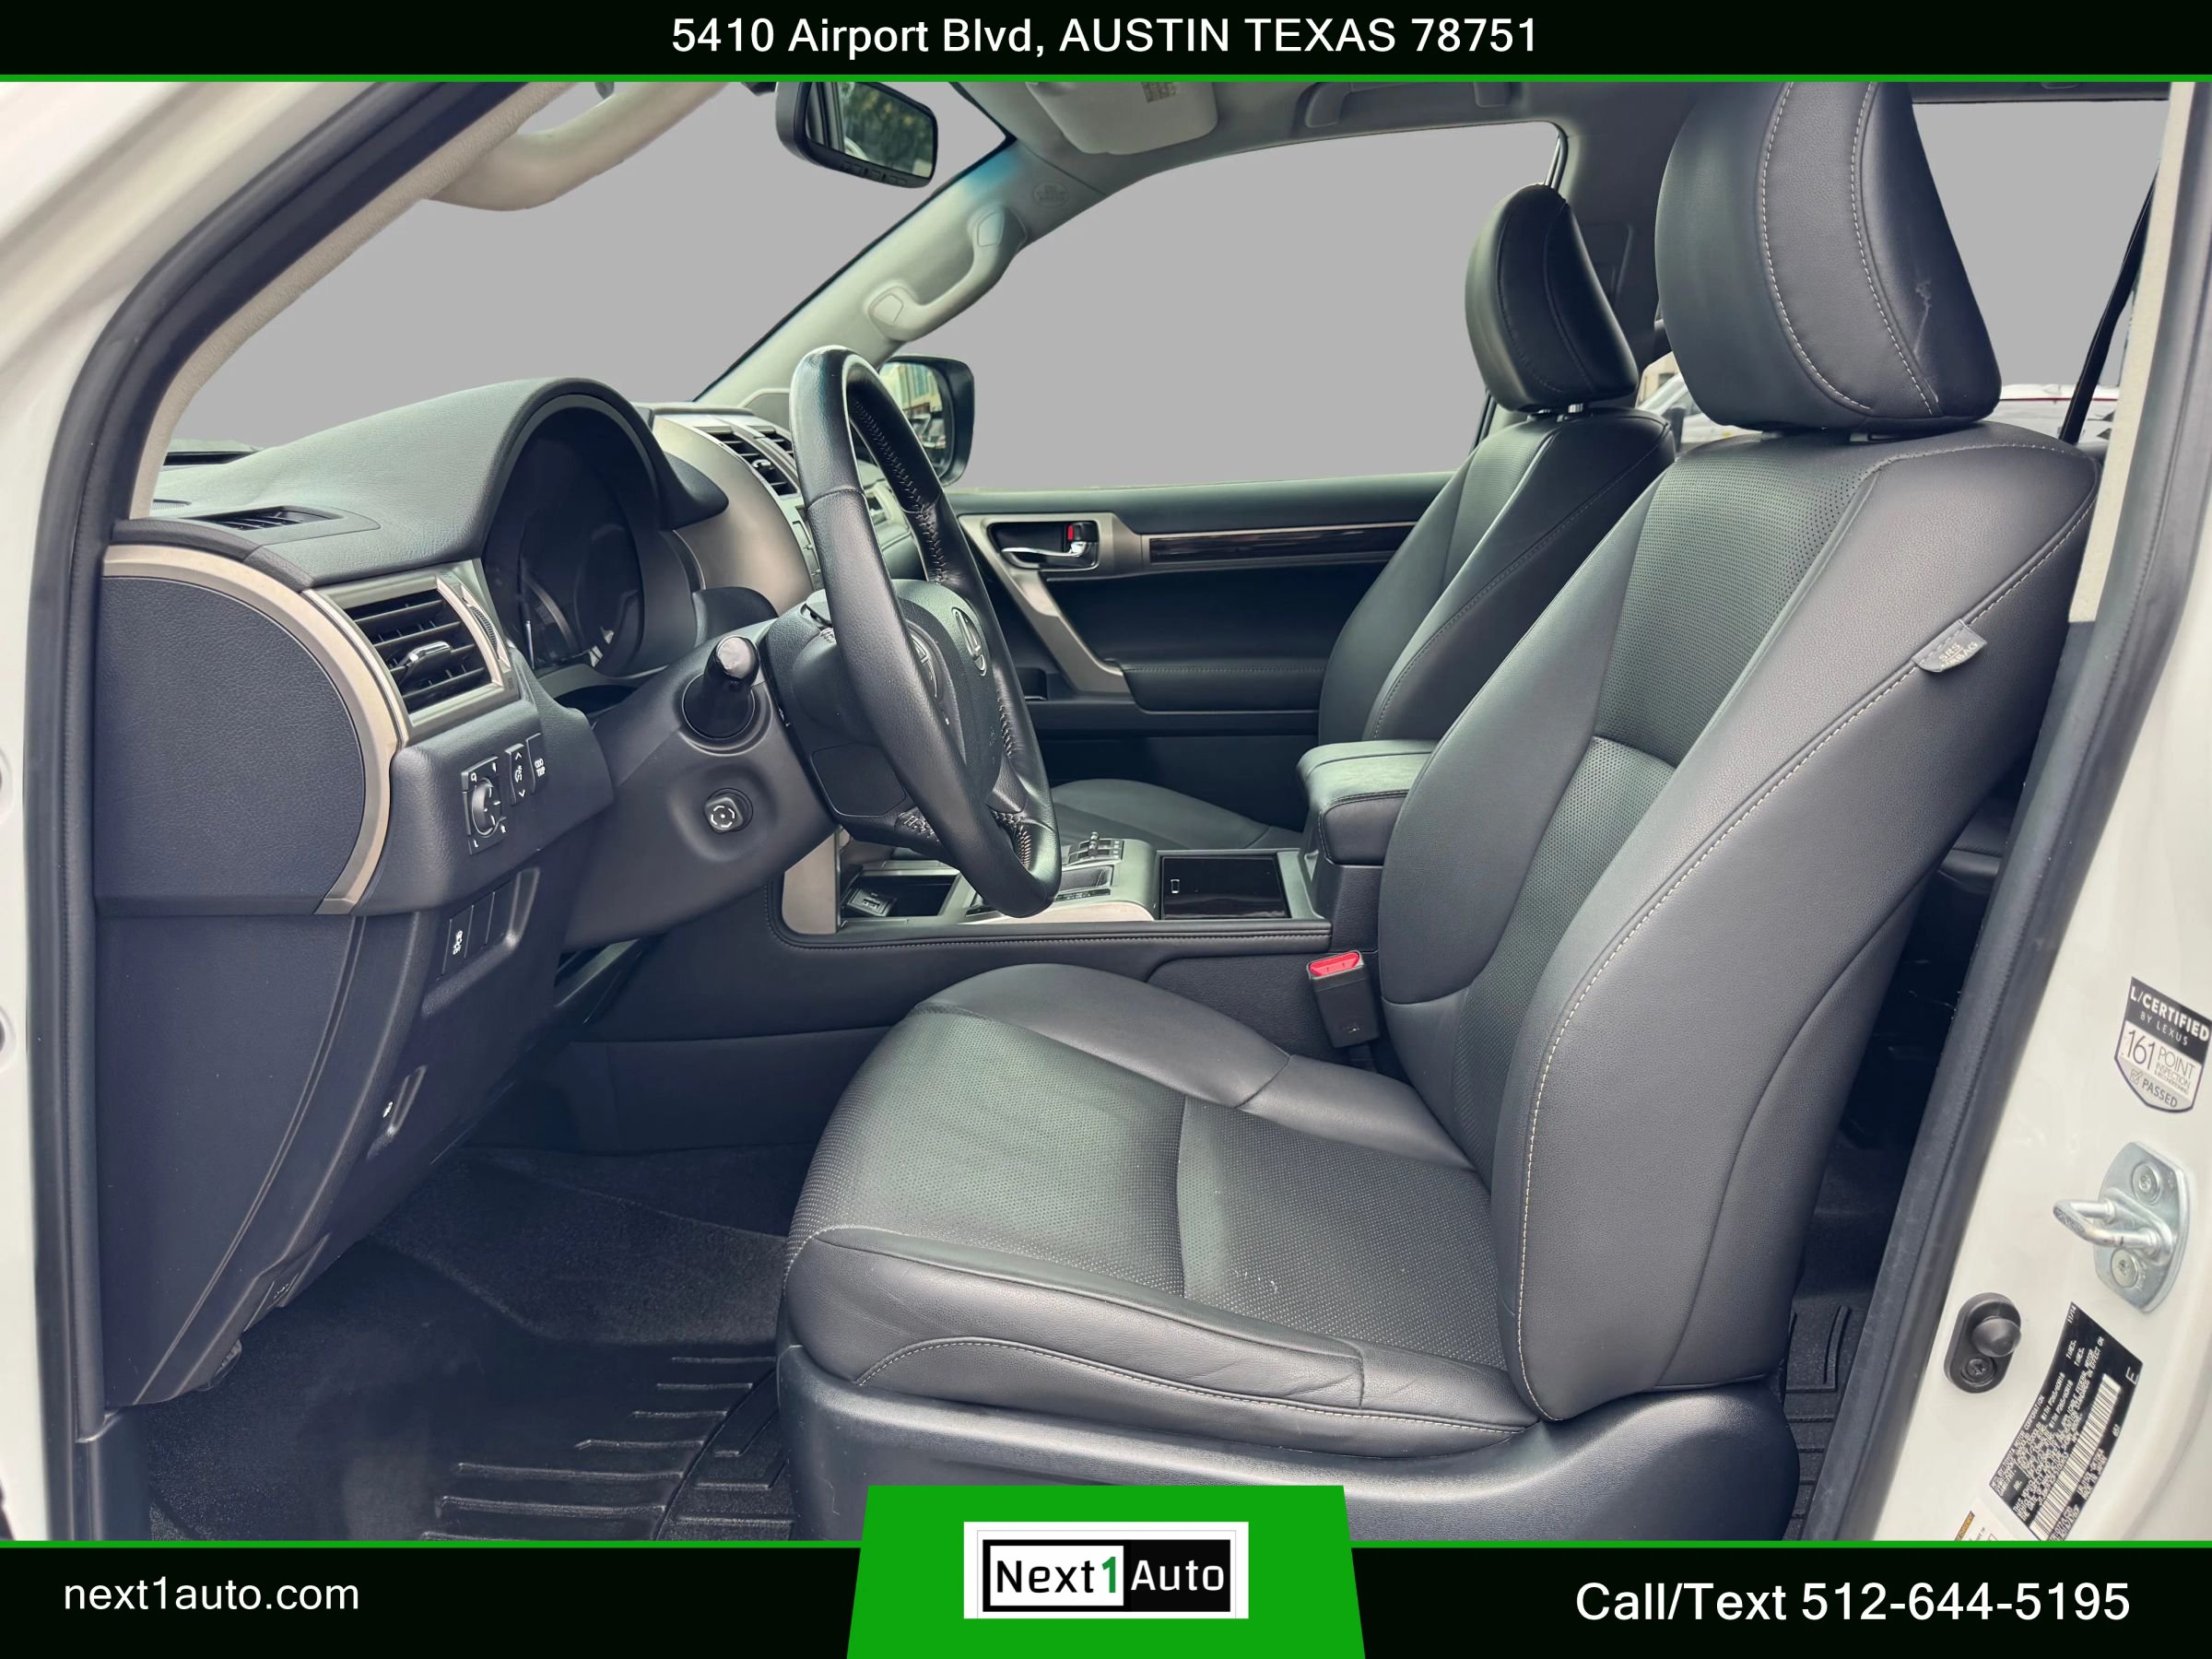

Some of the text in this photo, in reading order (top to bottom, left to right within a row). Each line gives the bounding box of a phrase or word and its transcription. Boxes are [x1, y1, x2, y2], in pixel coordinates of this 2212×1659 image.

[1939, 643, 1960, 661] SRS
[2130, 985, 2209, 1041] L/CERTIFIED
[2140, 1011, 2188, 1046] BY LEXUS
[2127, 1030, 2155, 1069] 161
[2158, 1046, 2195, 1079] POINT
[2155, 1063, 2190, 1089] INSPECTION
[2141, 1077, 2177, 1108] PASSED
[2066, 1341, 2076, 1359] TIRES.
[2074, 1348, 2084, 1366] TIRES.
[2024, 1395, 2044, 1430] CORPORATION
